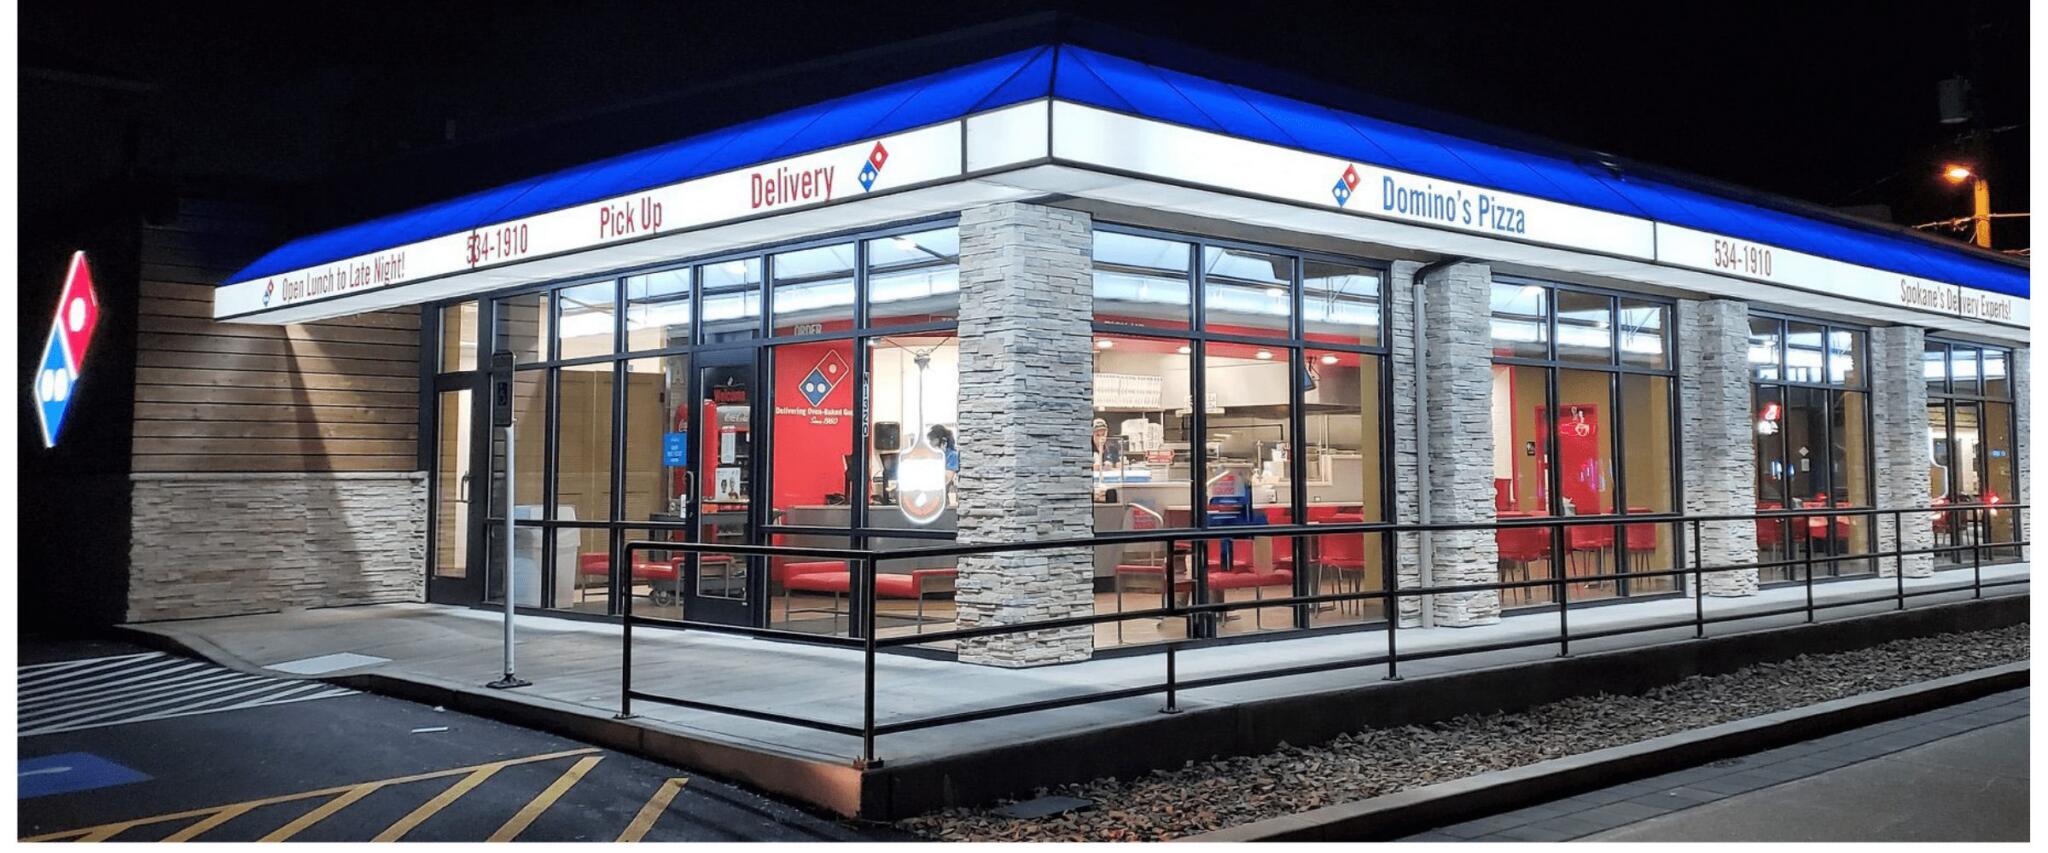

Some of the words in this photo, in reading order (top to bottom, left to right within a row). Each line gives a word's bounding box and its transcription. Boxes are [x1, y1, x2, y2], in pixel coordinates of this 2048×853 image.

[751, 166, 834, 208] Delivery
[1382, 175, 1472, 225] Domino's
[1479, 194, 1525, 234] Pizza
[600, 202, 634, 239] Pick
[641, 197, 662, 233] Up
[467, 223, 528, 264] 534-1910
[1714, 239, 1772, 277] 534-1910
[282, 278, 304, 304] Open
[307, 267, 334, 296] Lunch
[337, 267, 346, 290] to
[350, 262, 371, 288] Late
[374, 252, 405, 286] Night!
[1901, 278, 1944, 310] Spokane's
[1981, 294, 2012, 320] Experts!
